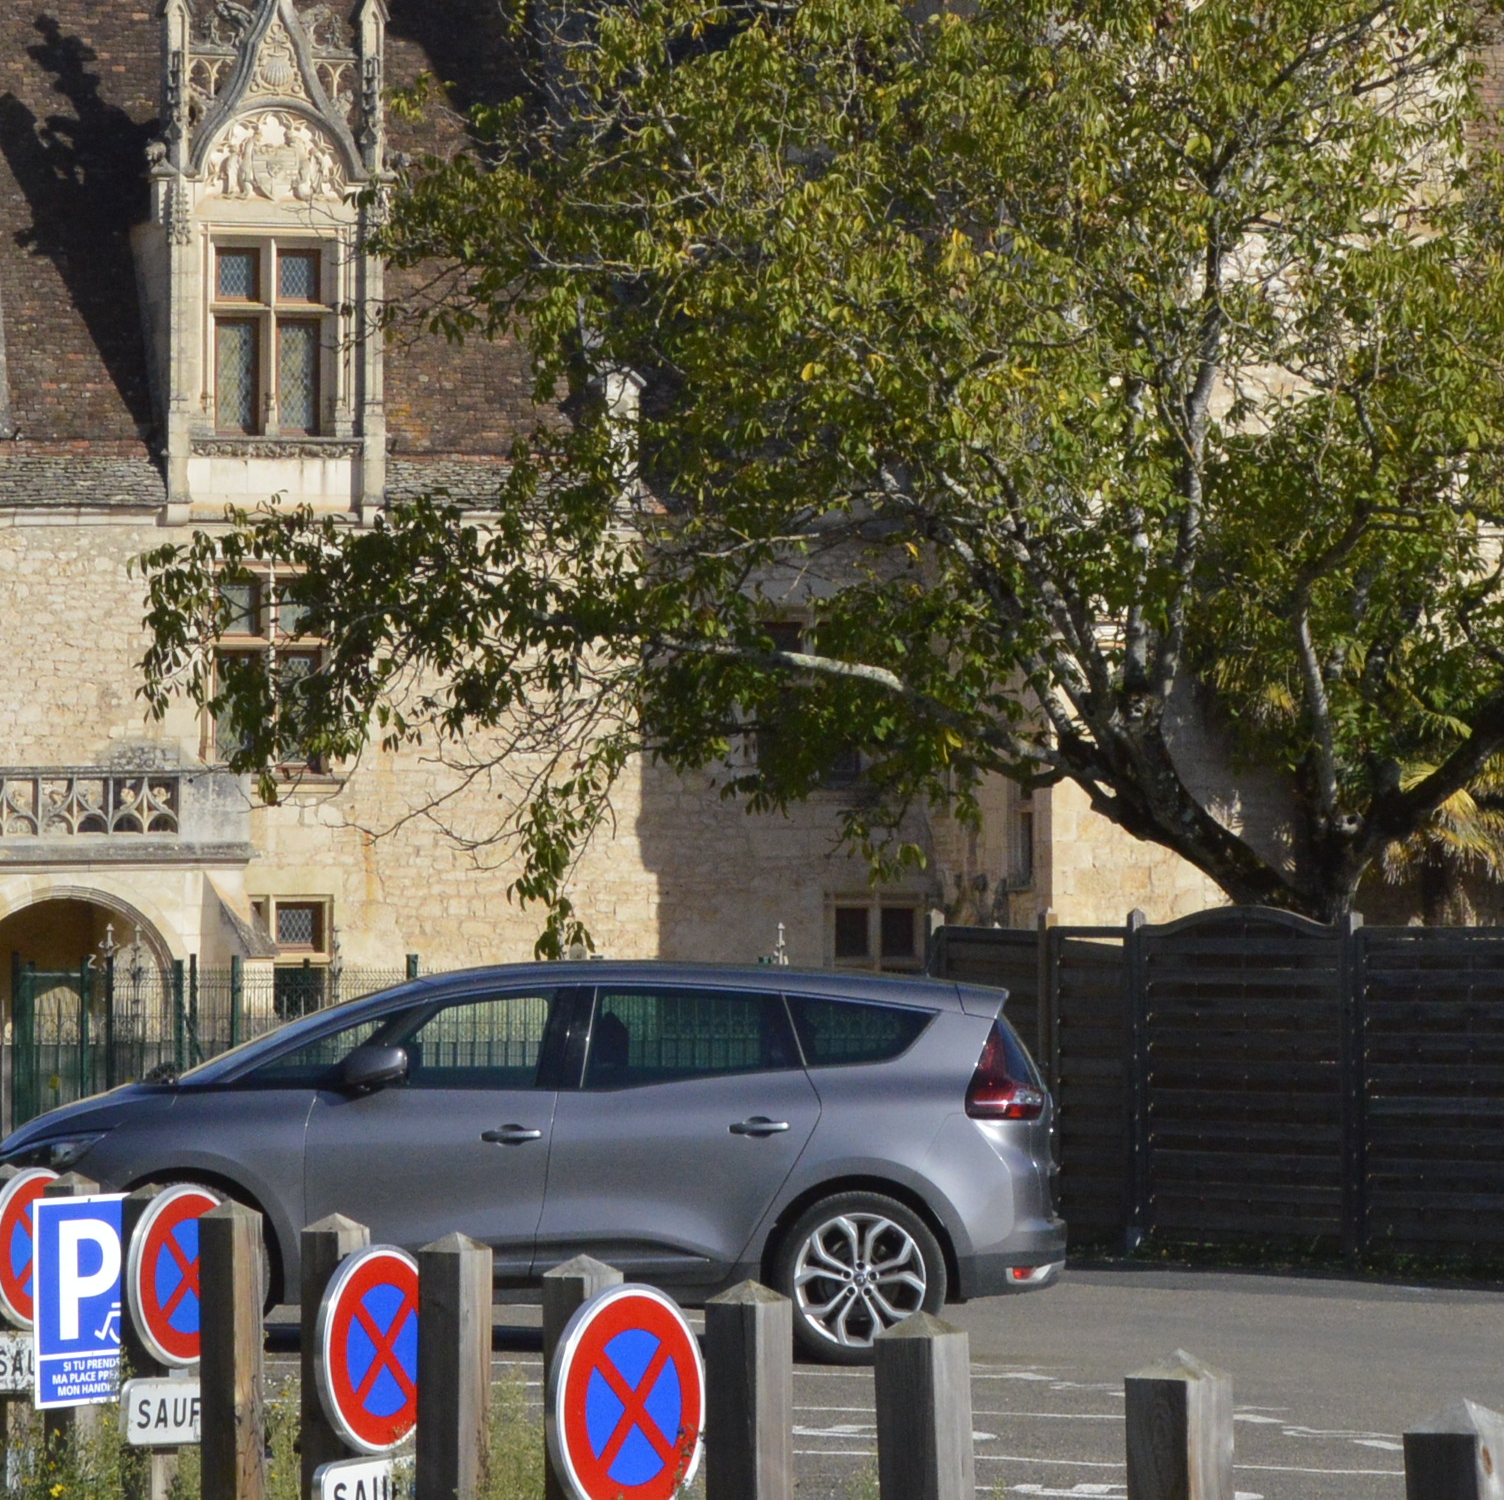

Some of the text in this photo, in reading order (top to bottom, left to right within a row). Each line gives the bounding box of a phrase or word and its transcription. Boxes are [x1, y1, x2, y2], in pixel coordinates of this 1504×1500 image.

[59, 1218, 121, 1341] P
[63, 1361, 72, 1372] SI
[73, 1359, 86, 1371] TU
[52, 1374, 69, 1385] MA
[70, 1370, 96, 1383] PLACE
[57, 1385, 80, 1396] MON
[137, 1397, 201, 1429] SAUF
[333, 1475, 396, 1500] SAU
